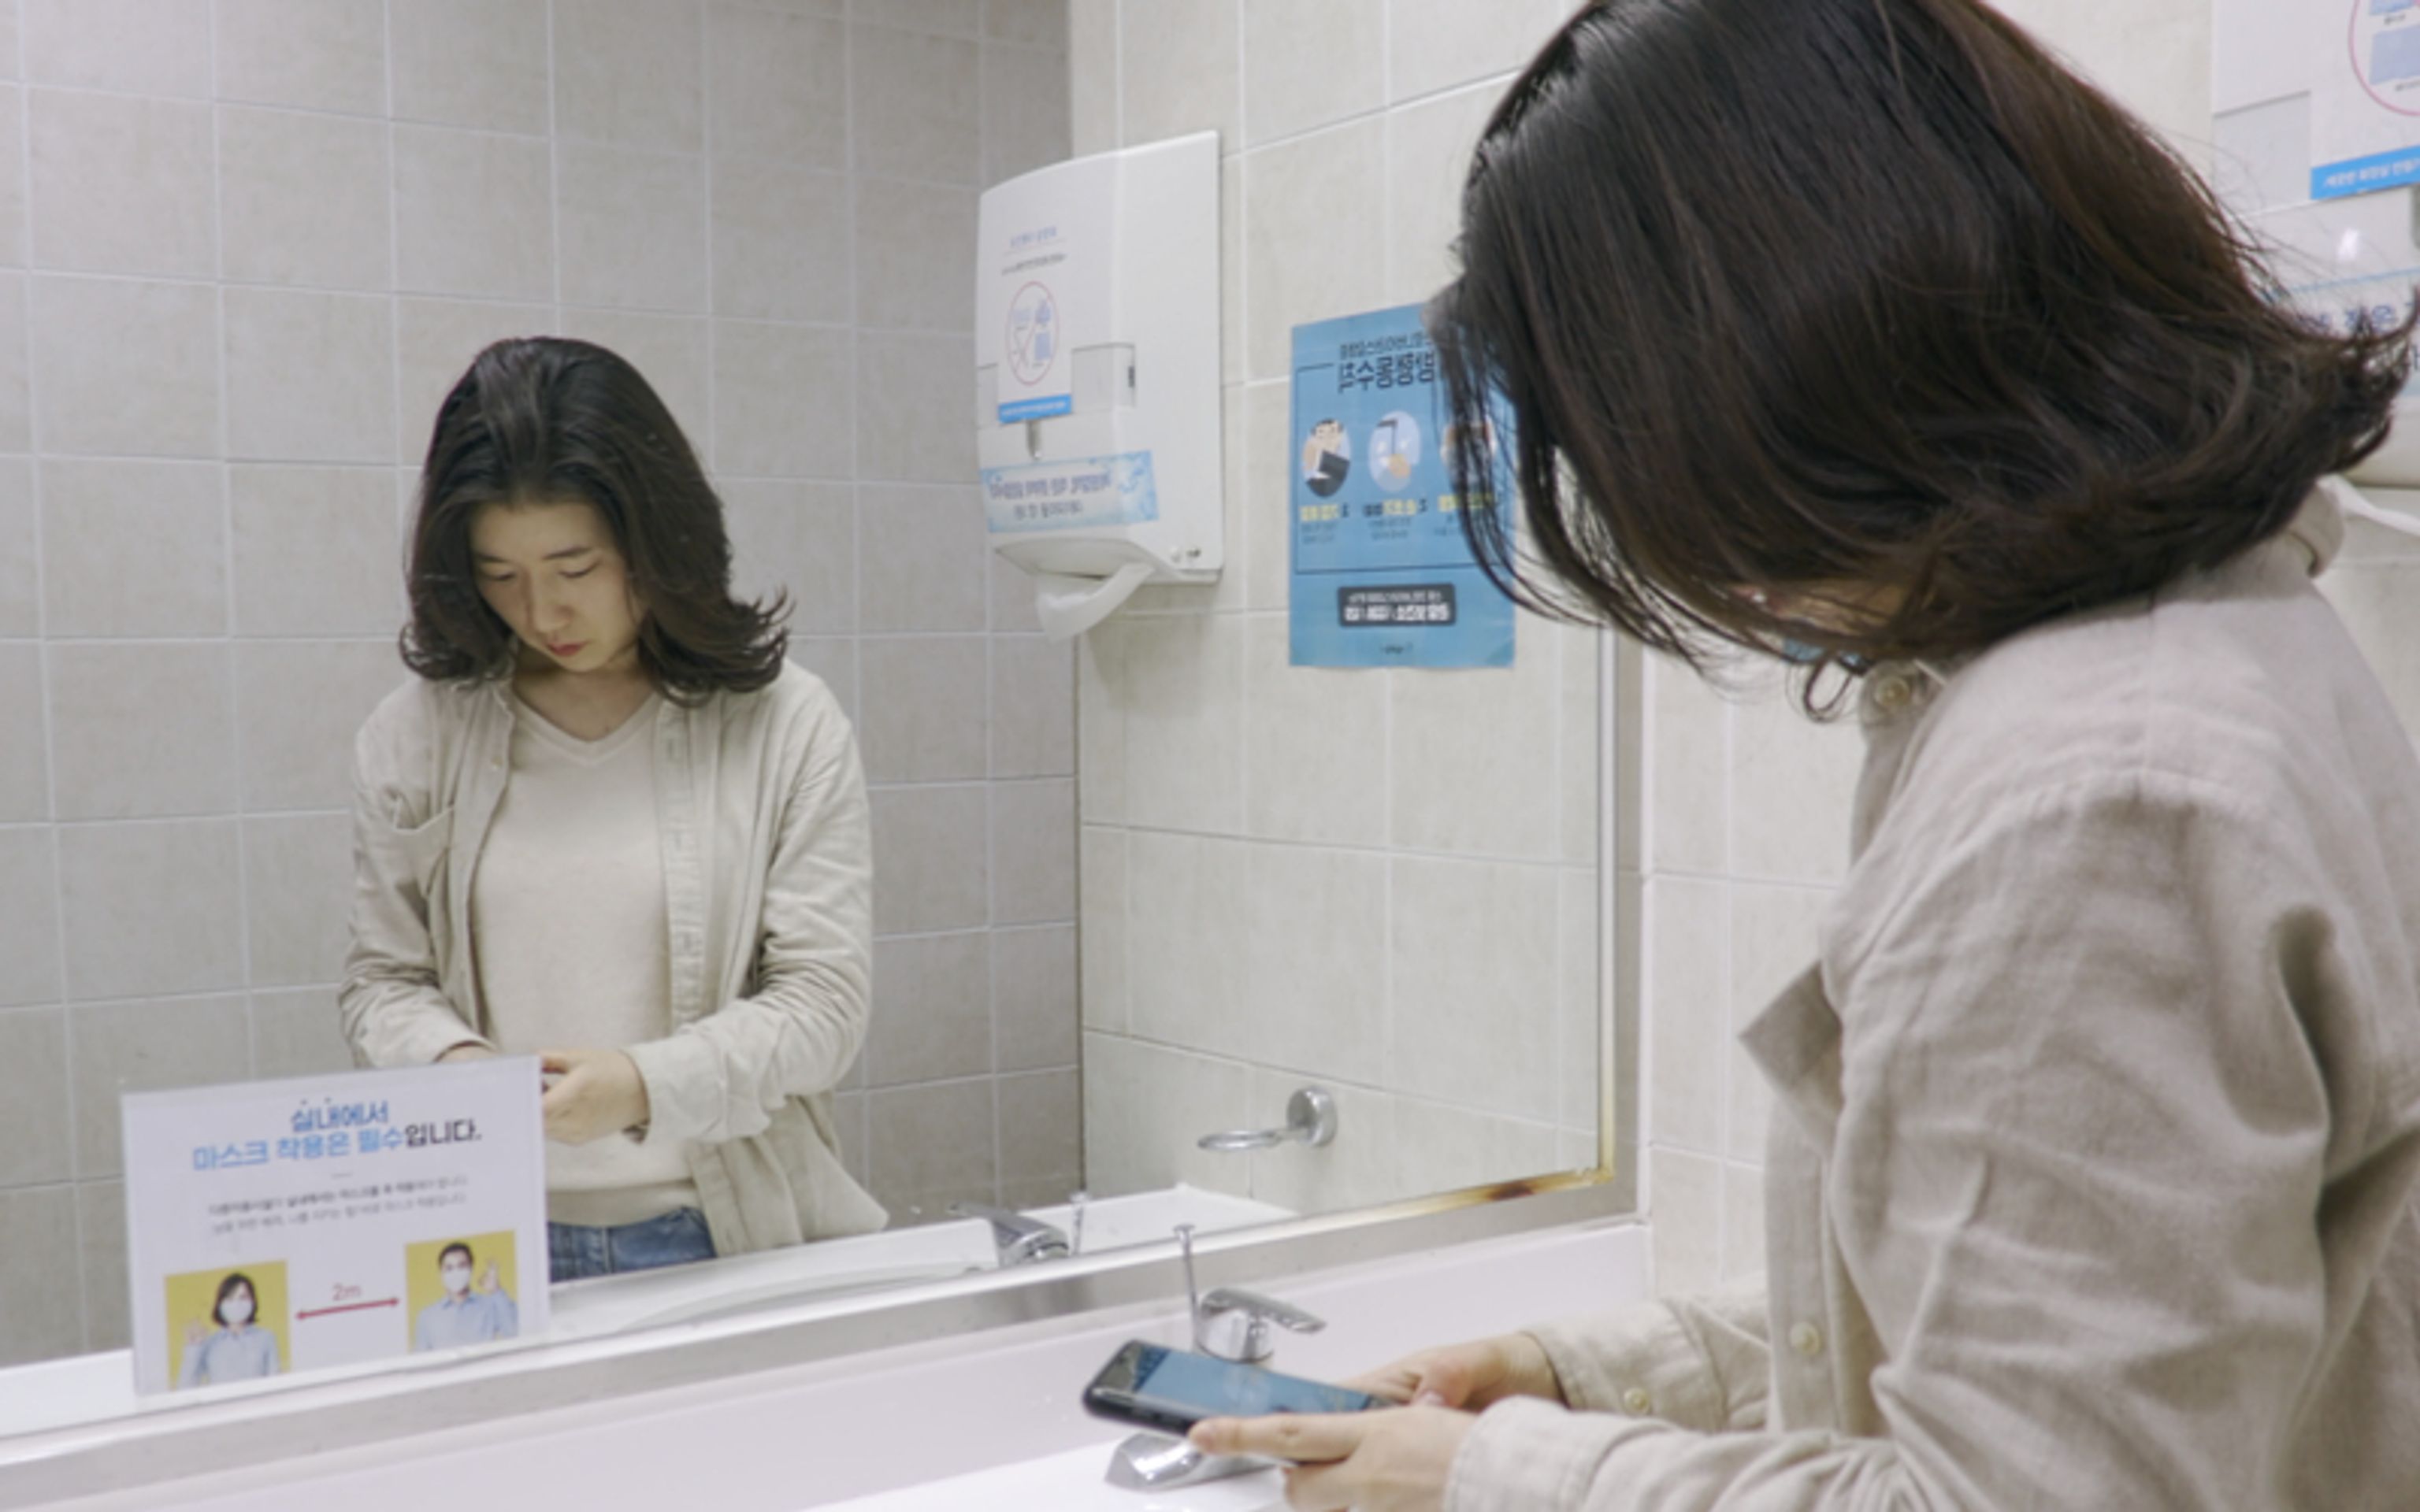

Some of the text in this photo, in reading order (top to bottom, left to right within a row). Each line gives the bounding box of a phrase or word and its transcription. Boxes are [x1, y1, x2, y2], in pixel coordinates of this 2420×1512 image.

[291, 1101, 389, 1133] 실내에서
[193, 1118, 481, 1170] 마스크 착용은 필수입니다.
[332, 1284, 362, 1302] 2m
